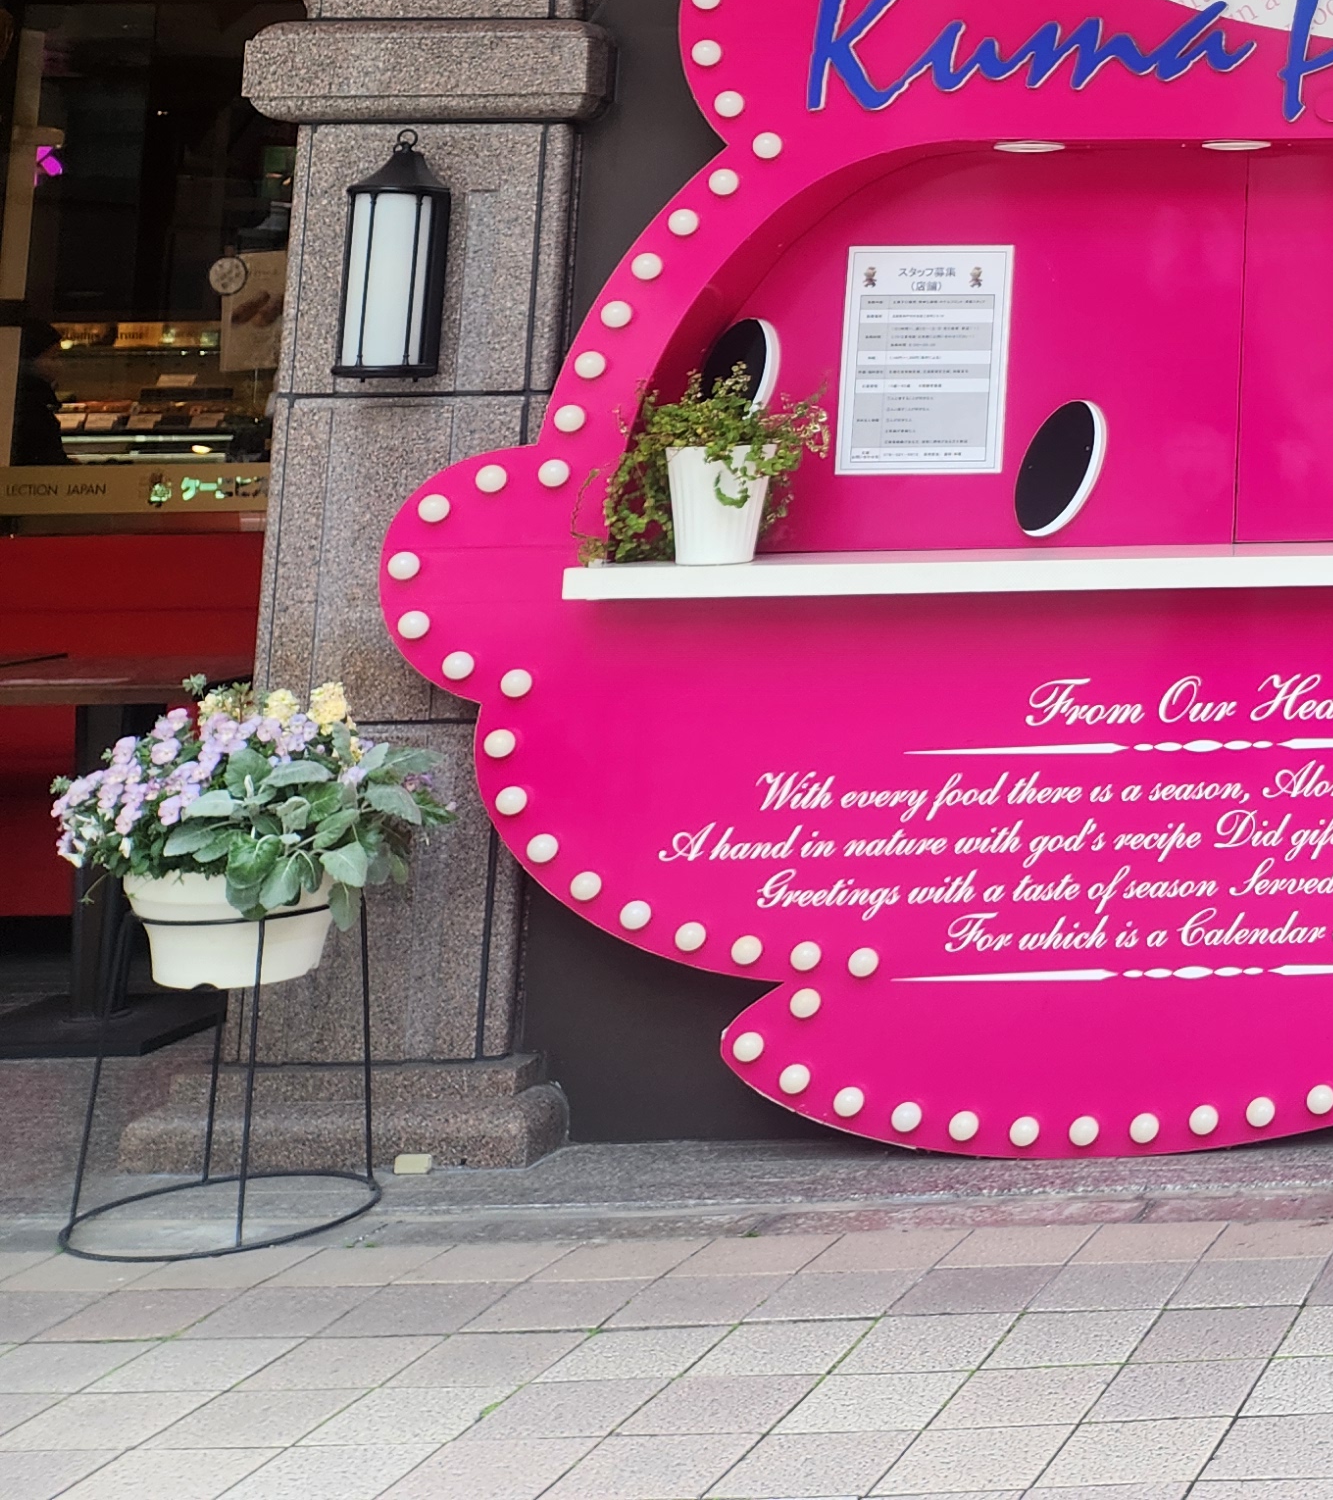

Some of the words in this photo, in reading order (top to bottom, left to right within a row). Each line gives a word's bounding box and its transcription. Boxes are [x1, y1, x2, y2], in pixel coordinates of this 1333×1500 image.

[66, 482, 107, 497] JAPAN
[1025, 677, 1146, 727] From
[1157, 675, 1237, 723] Our
[755, 770, 835, 812] With
[840, 781, 929, 823] every
[926, 771, 1007, 821] food
[1006, 770, 1082, 806] there
[1089, 782, 1115, 803] is
[1120, 781, 1143, 802] a
[1148, 779, 1252, 805] season,
[657, 821, 704, 863] A
[710, 824, 804, 861] hand
[801, 831, 836, 858] in
[842, 827, 947, 858] nature
[953, 820, 1021, 855] with
[1114, 821, 1202, 863] recipe
[1214, 807, 1285, 849] Did
[756, 868, 902, 920] Greetings
[907, 868, 978, 905] with
[981, 883, 1005, 903] a
[1012, 873, 1081, 902] taste
[1087, 865, 1131, 914] of
[1123, 876, 1218, 901] season
[944, 911, 1013, 953] For
[1018, 912, 1109, 951] which
[1114, 927, 1139, 950] is
[1146, 928, 1168, 949] a
[1178, 907, 1326, 948] Calendar
